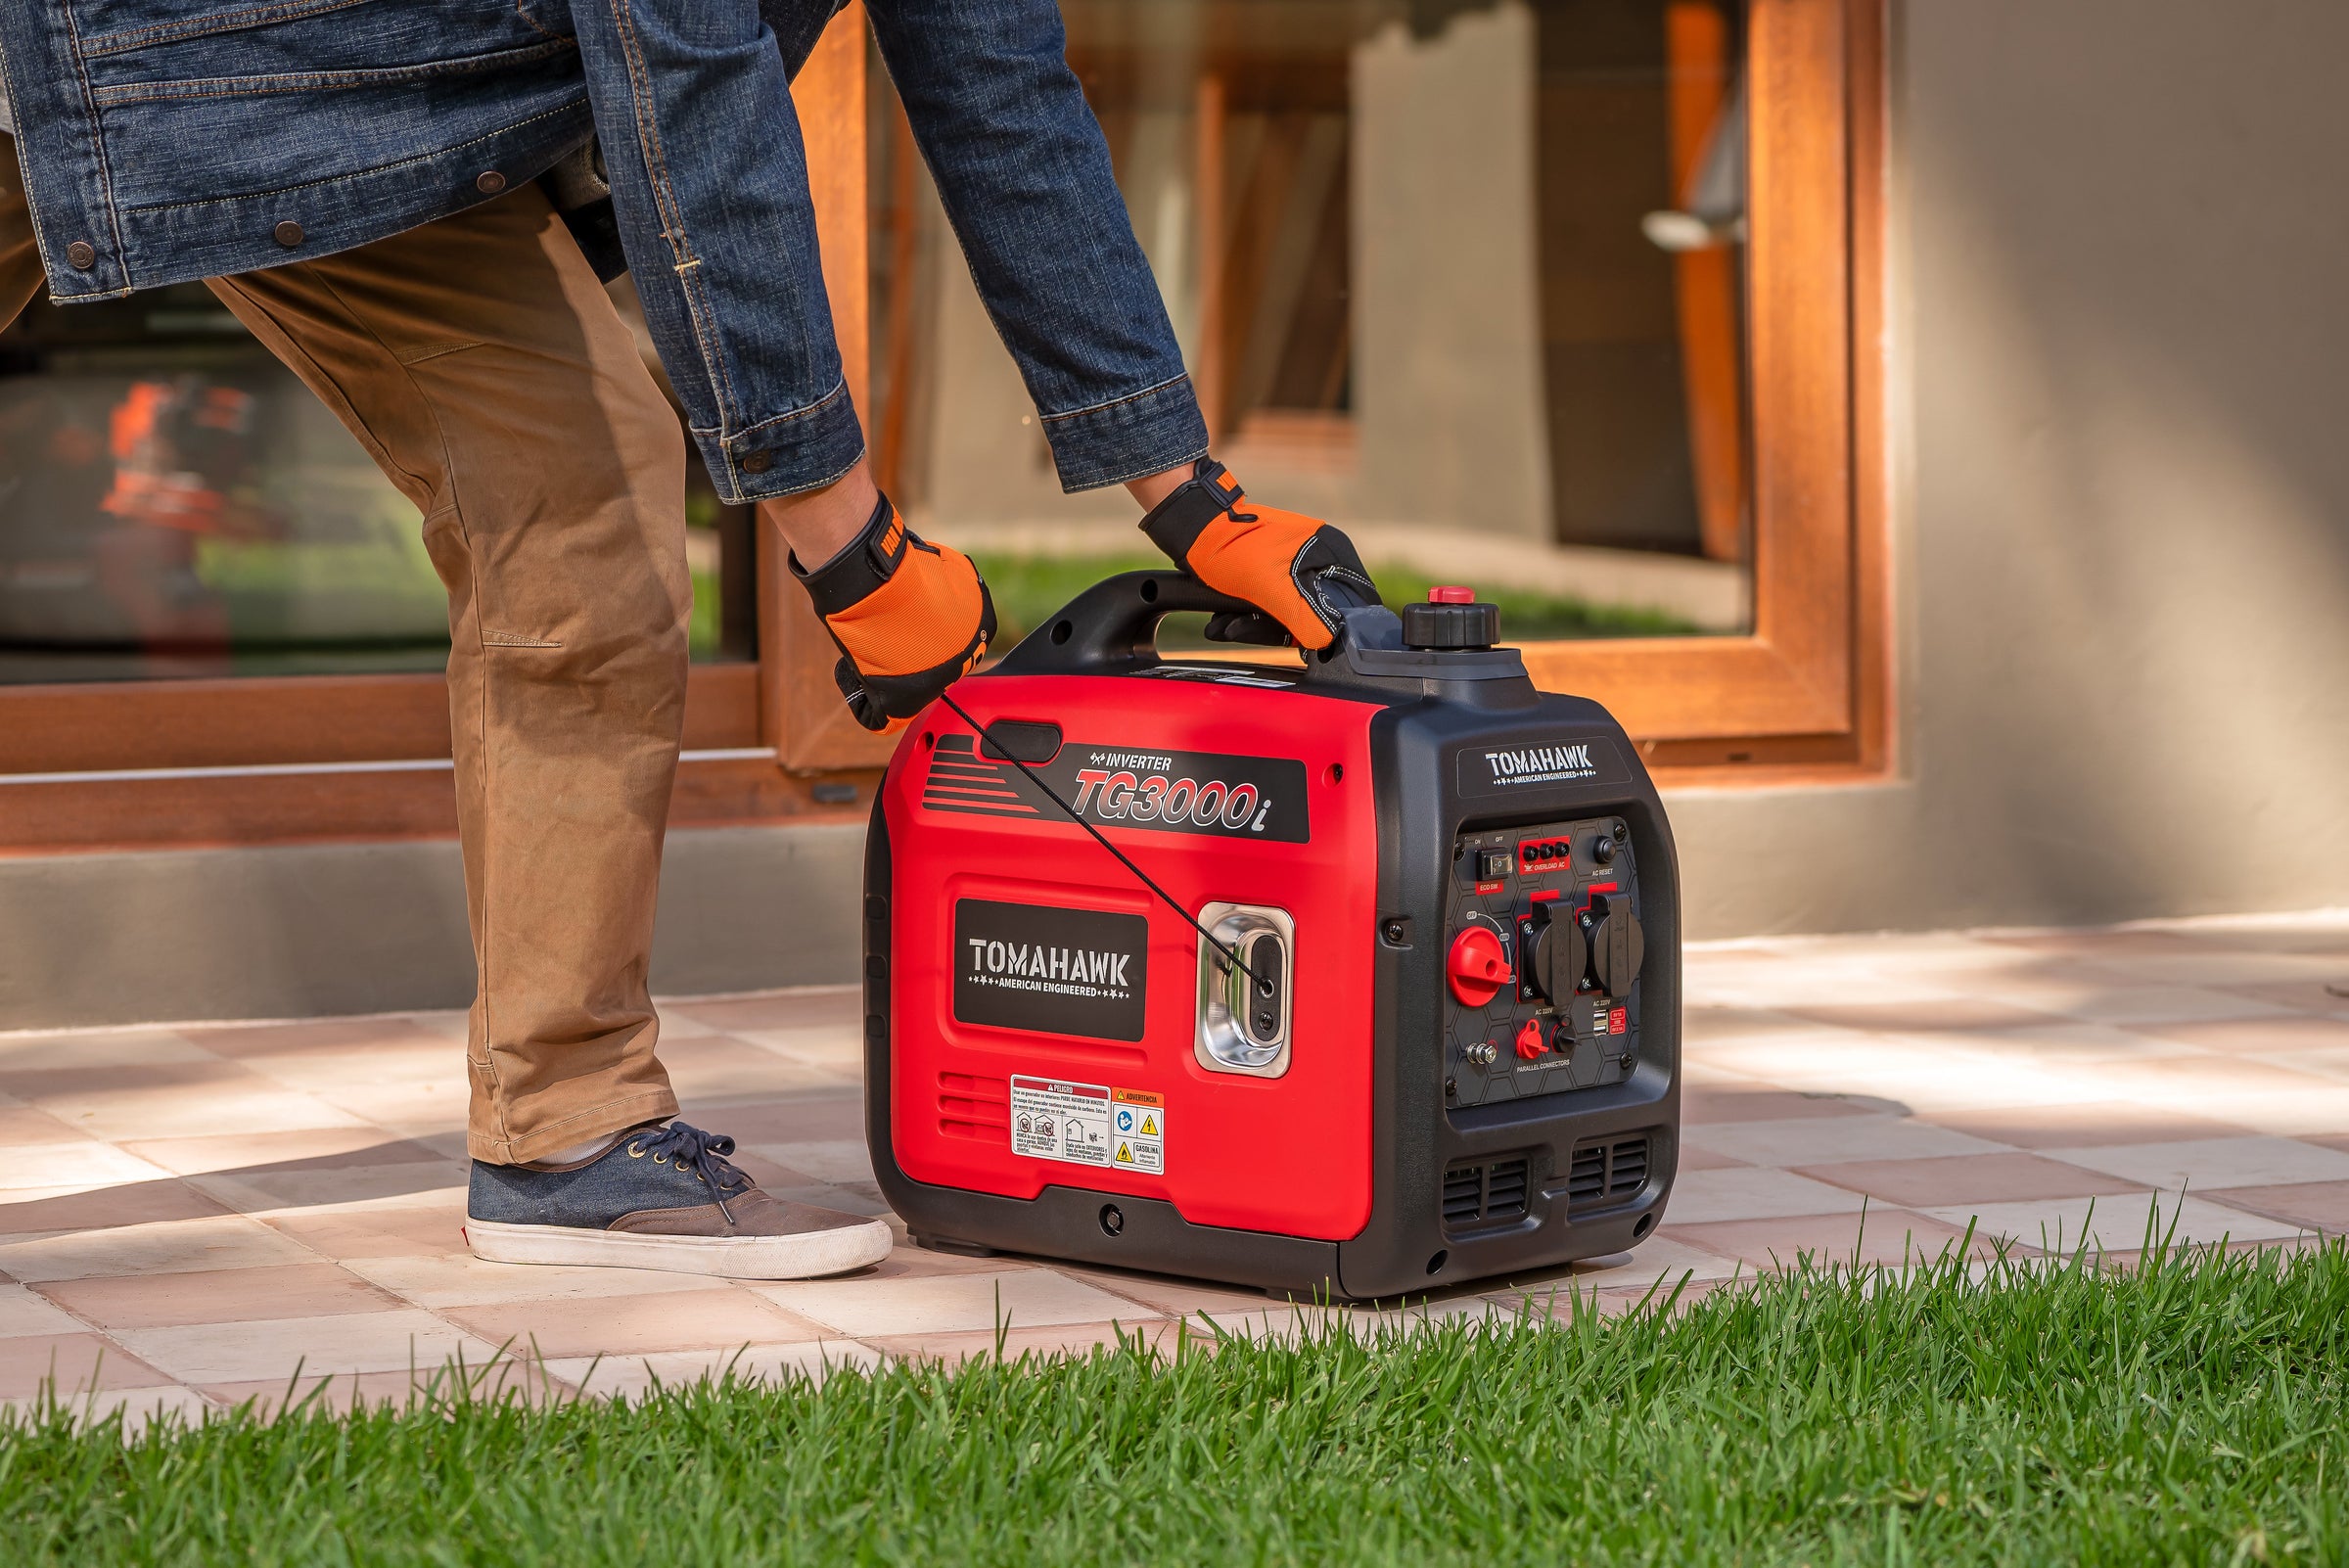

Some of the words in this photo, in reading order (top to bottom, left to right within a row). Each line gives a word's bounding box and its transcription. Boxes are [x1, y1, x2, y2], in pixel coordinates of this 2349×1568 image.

[1105, 753, 1173, 771] INVERTER
[1485, 745, 1593, 776] TOMAHAWK
[1513, 773, 1543, 784] AMERICAN
[1543, 770, 1577, 782] ENGINEERED
[969, 938, 1130, 987] TOMAHAWK
[998, 978, 1041, 992] AMERICAN
[1042, 982, 1097, 997] ENGINEERED
[1516, 1064, 1540, 1073] PARALLEL
[1540, 1059, 1570, 1069] CONNECTORS
[1053, 1084, 1074, 1094] PELIGRO
[1126, 1092, 1157, 1103] ADVERTENCIA
[1135, 1144, 1159, 1154] GASOLINA
